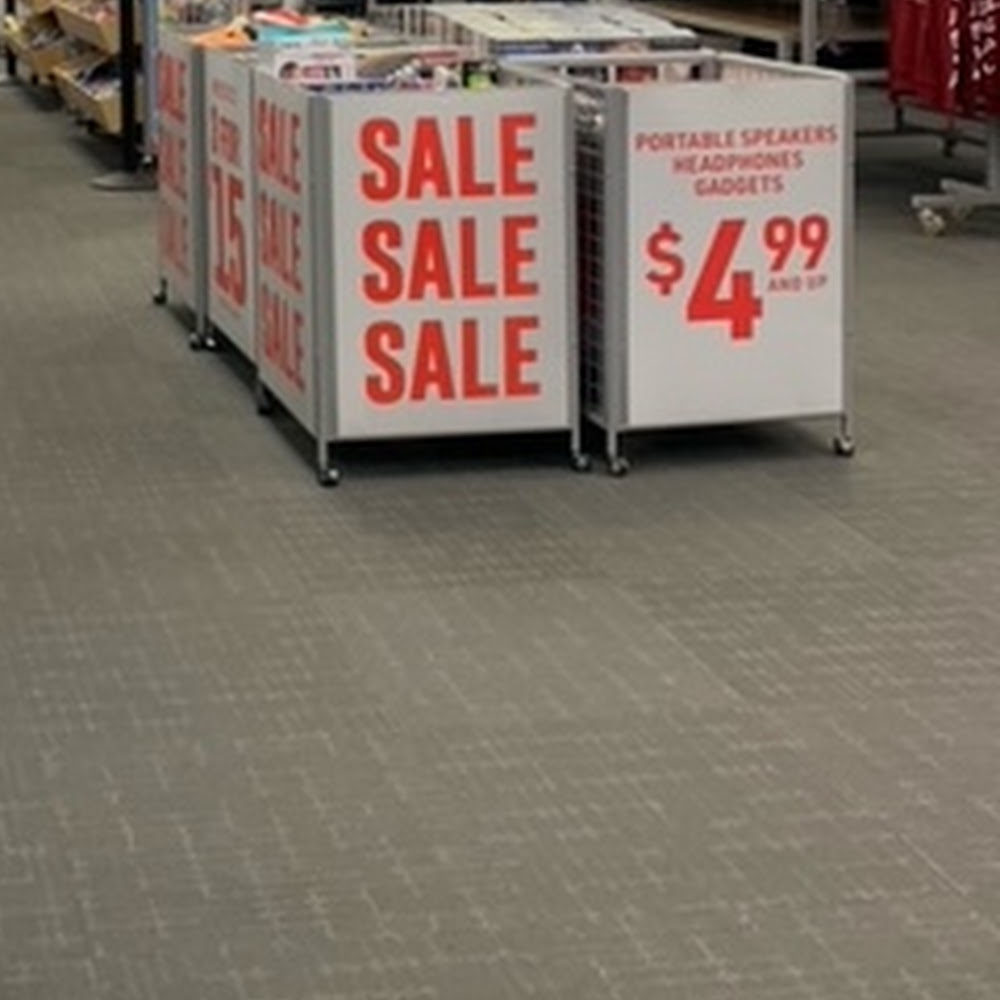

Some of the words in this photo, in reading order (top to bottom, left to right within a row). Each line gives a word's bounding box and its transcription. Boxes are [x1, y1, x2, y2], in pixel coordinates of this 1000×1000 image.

[258, 98, 300, 194] SALE
[361, 114, 538, 201] SALE
[635, 130, 734, 150] PORTABLE
[739, 124, 838, 146] SPEAKERS
[672, 151, 804, 174] HEADPHONES
[694, 175, 784, 197] GADGETS
[259, 191, 302, 295] SALE
[362, 215, 540, 303] SALE
[262, 284, 305, 393] SALE
[364, 316, 541, 404] SALE
